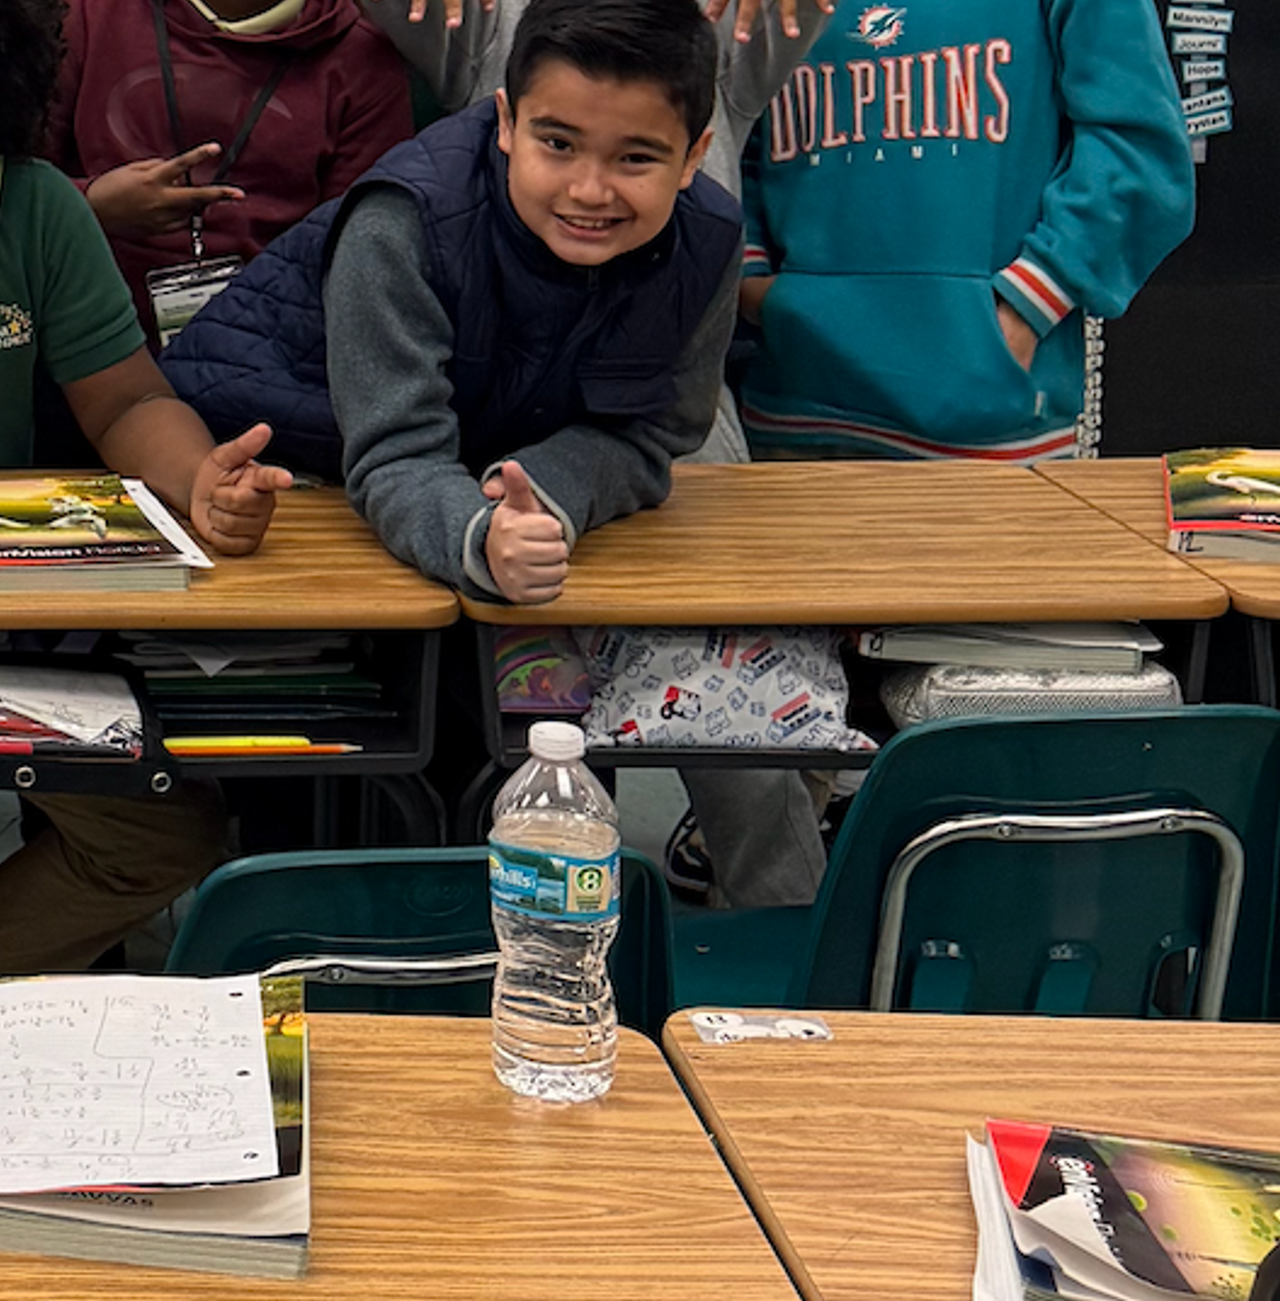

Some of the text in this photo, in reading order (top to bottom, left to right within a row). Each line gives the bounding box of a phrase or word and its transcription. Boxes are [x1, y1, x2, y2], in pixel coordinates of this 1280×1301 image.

[1187, 64, 1220, 78] Hope
[770, 39, 1012, 163] DOLPHINS
[810, 143, 960, 167] MIAMI
